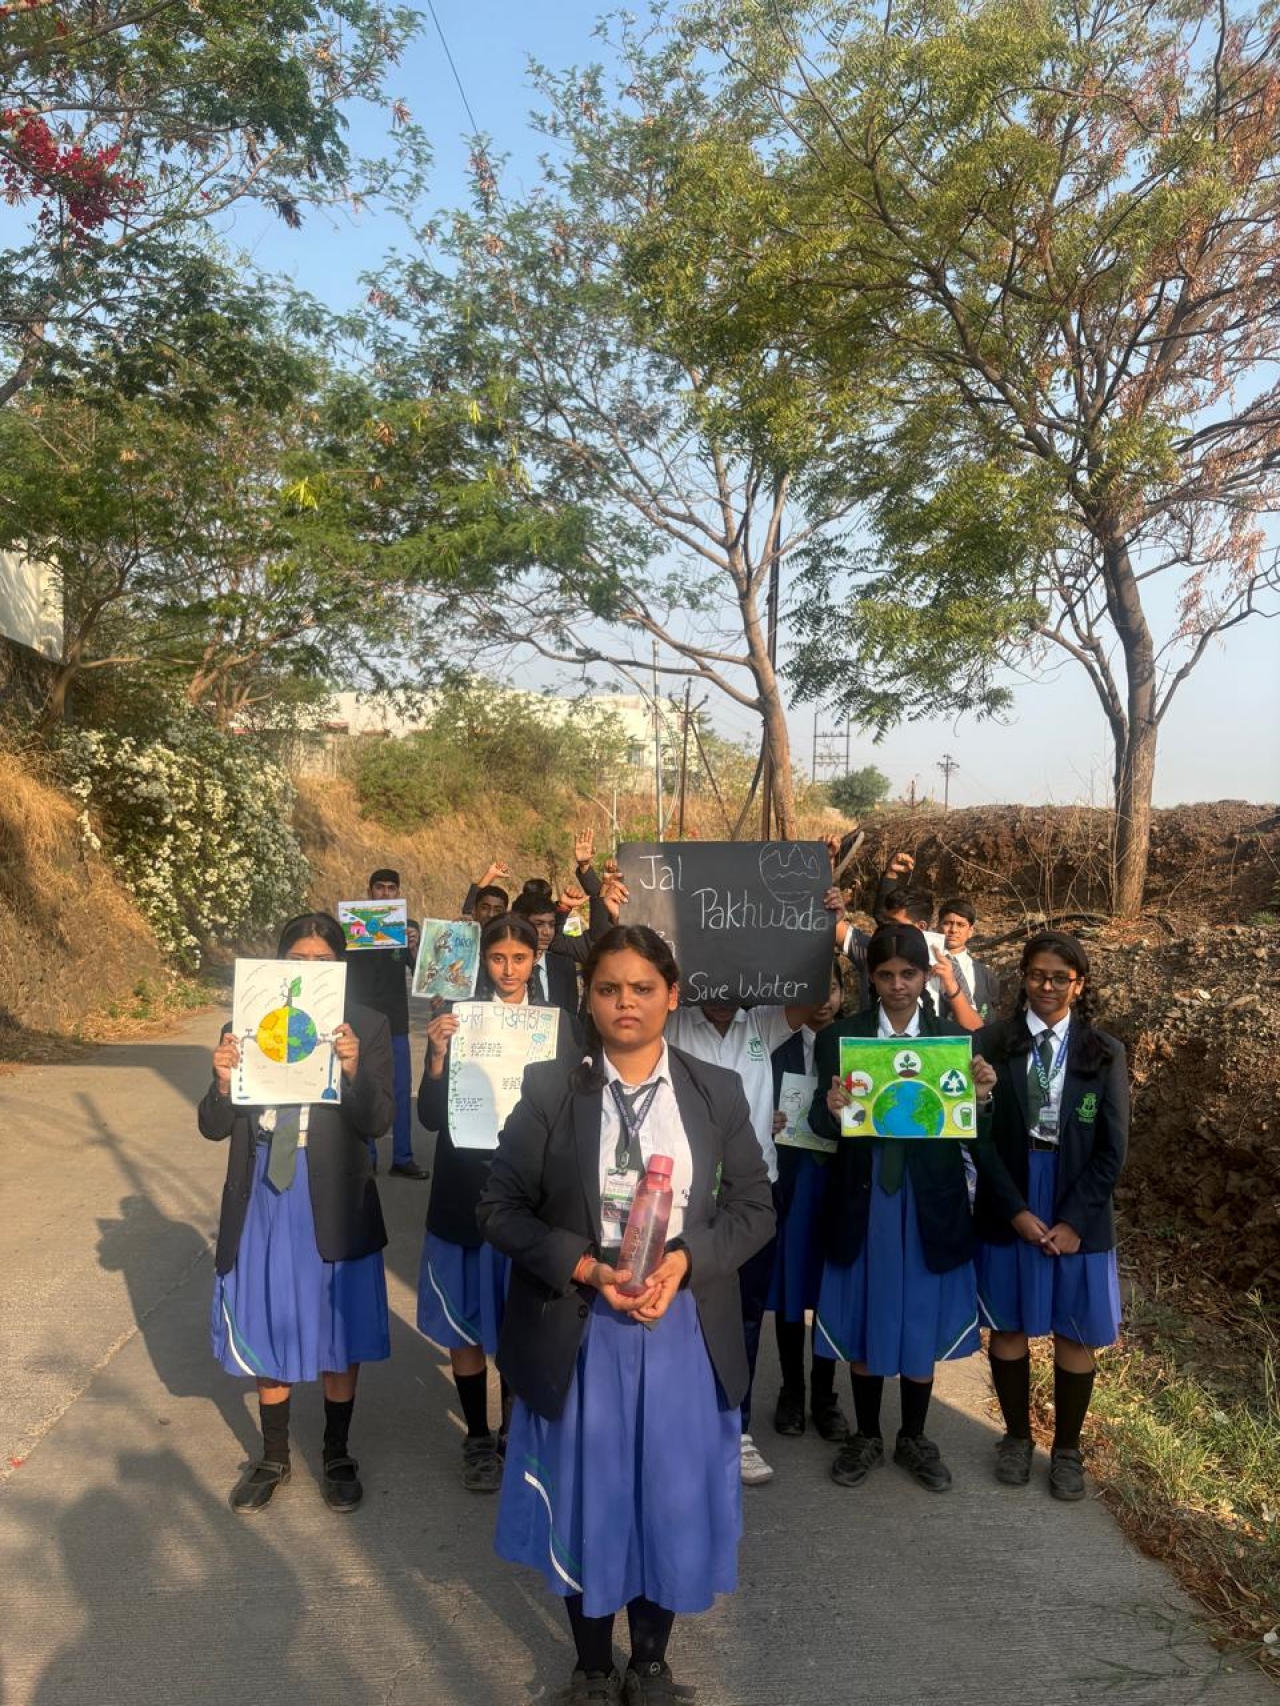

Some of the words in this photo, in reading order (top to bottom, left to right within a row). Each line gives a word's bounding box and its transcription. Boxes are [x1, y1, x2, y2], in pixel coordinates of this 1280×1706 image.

[639, 854, 685, 891] Jal
[691, 887, 829, 932] Pakhwada
[687, 972, 730, 1001] Save
[739, 971, 809, 999] Water
